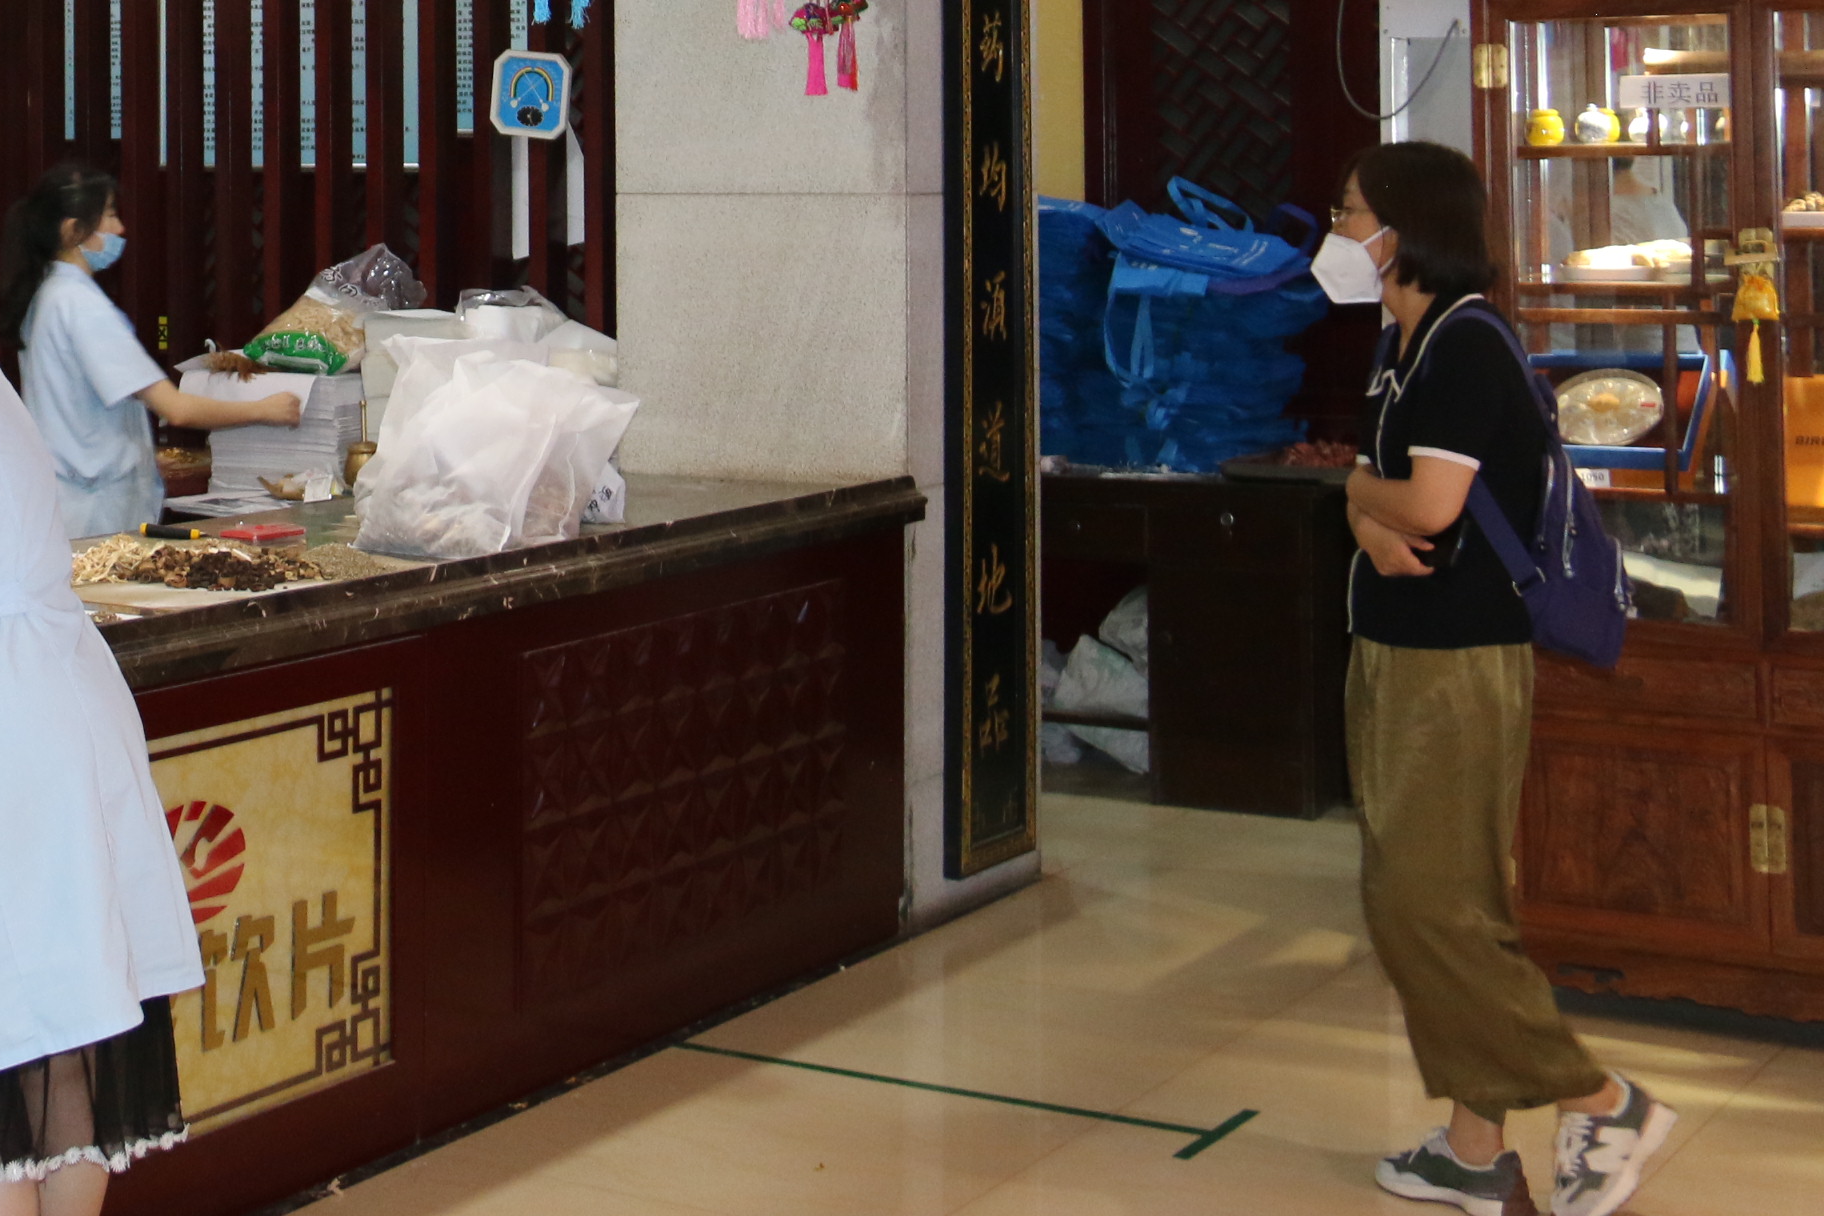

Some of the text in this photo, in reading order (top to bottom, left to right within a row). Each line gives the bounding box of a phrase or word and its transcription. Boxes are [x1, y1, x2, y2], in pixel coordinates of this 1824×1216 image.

[1641, 81, 1718, 105] 非卖品
[1795, 435, 1824, 446] BIR
